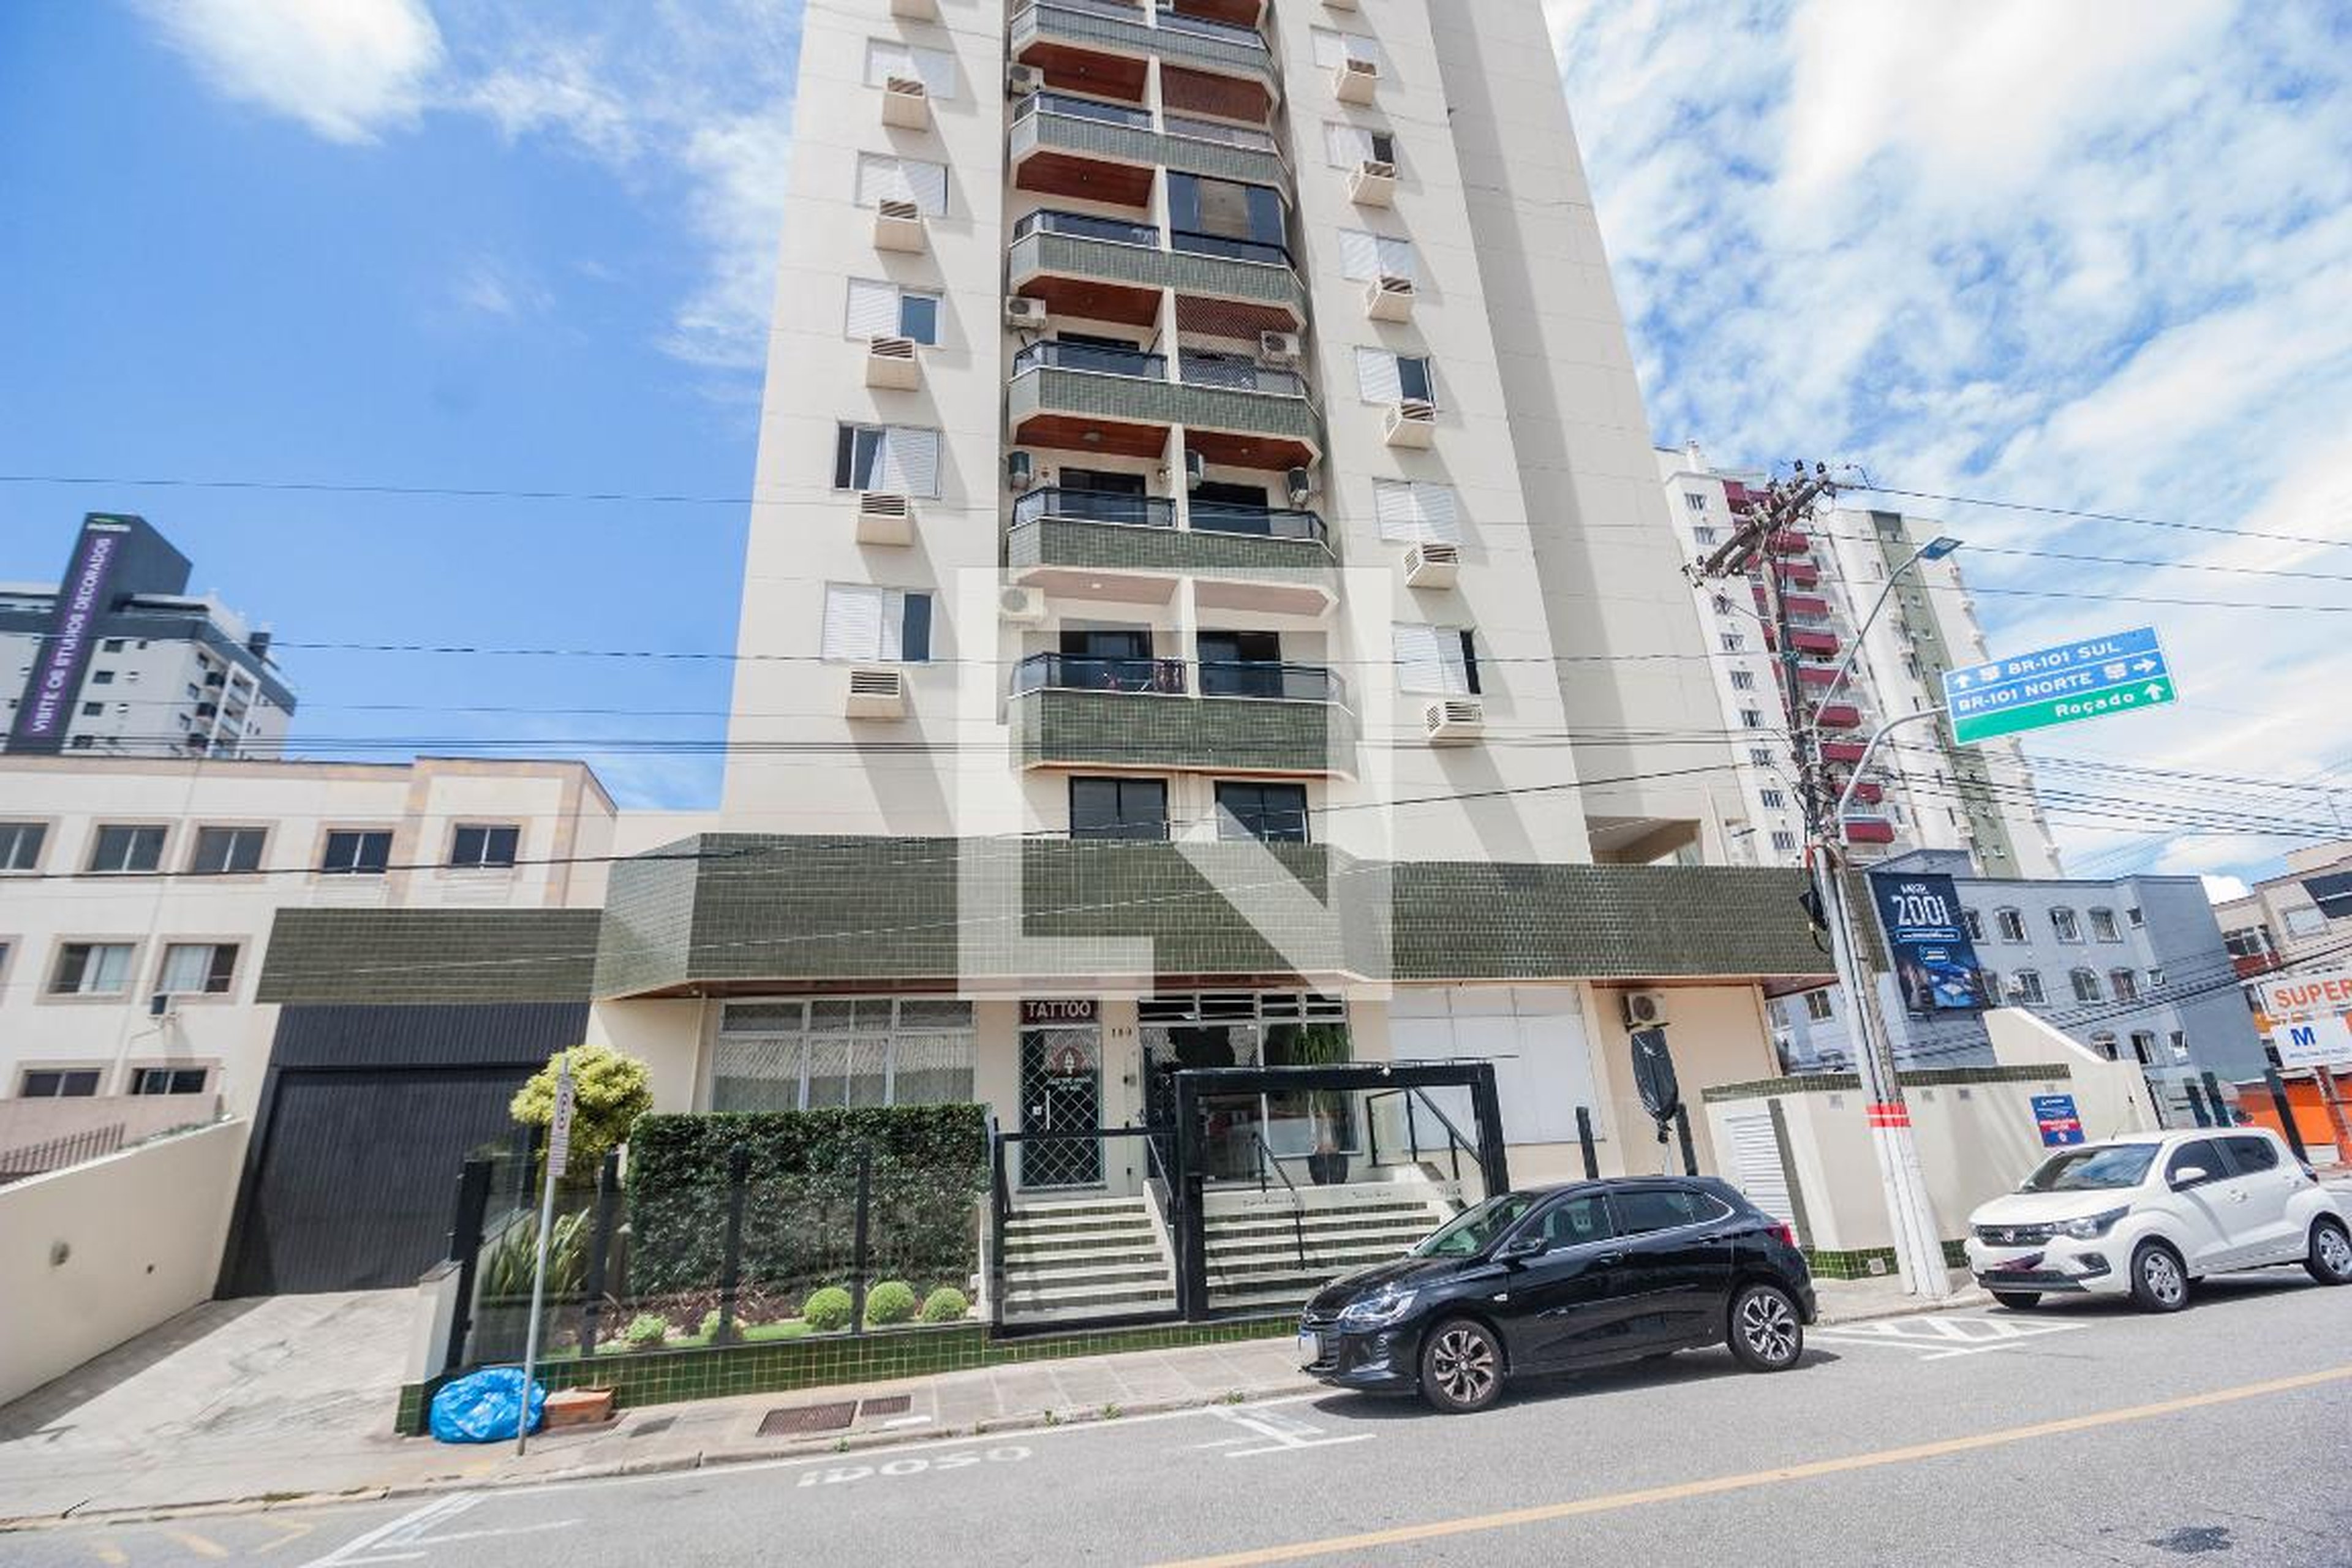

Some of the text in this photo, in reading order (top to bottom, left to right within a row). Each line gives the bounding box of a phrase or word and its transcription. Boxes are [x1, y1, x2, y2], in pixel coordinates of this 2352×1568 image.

[32, 692, 59, 732] VISITE
[47, 669, 66, 689] OS
[74, 538, 111, 609] DECORADOS
[2008, 642, 2121, 674] BR-101 SUL
[1959, 673, 2094, 711] BR-101 NORTE
[2055, 693, 2135, 718] Roçado
[1890, 895, 1952, 925] 2001
[1027, 1001, 1091, 1017] TATTOO
[2290, 1026, 2316, 1046] M
[797, 1446, 1033, 1487] IDOSO
